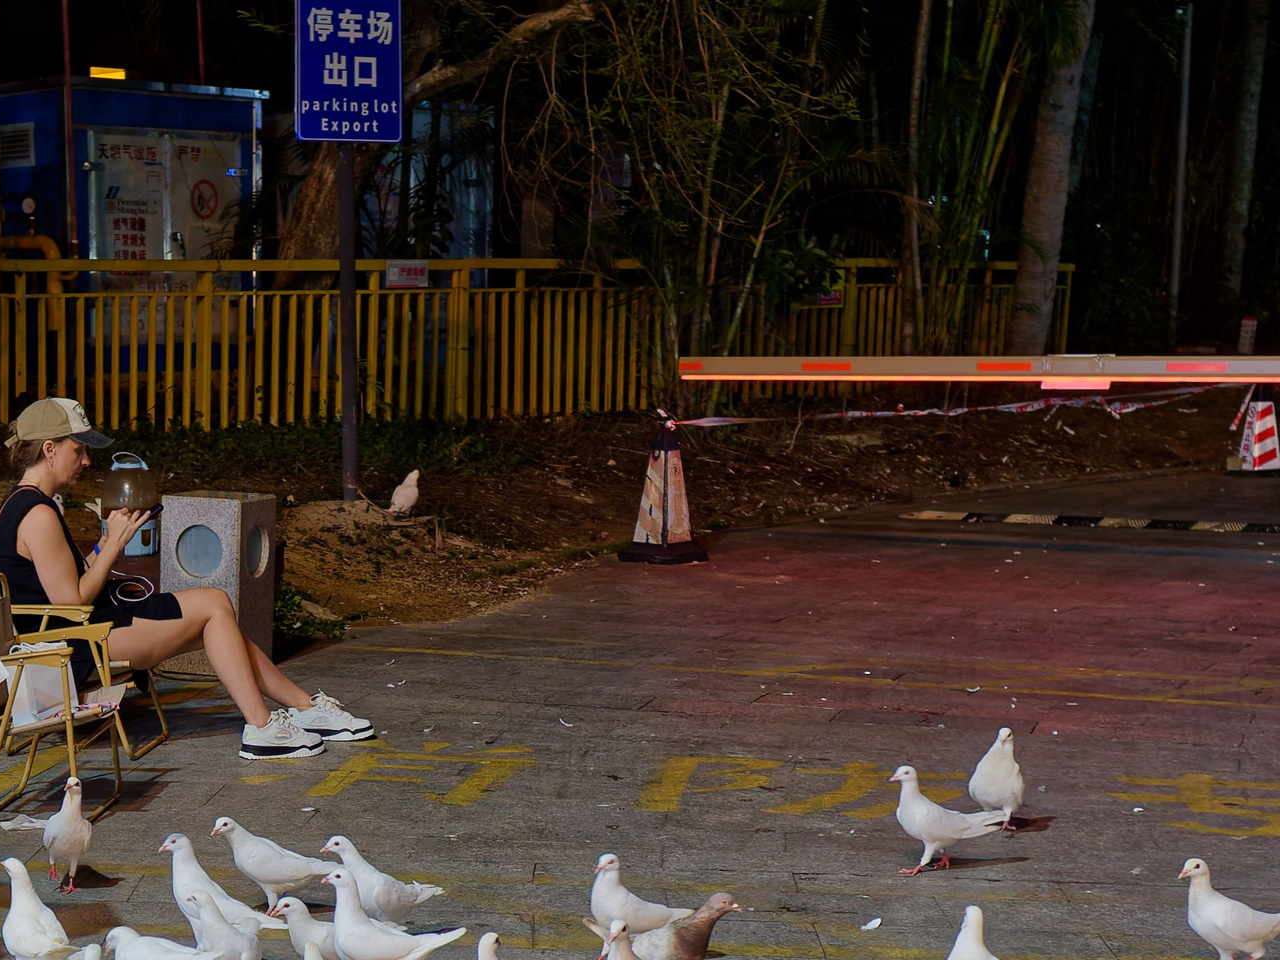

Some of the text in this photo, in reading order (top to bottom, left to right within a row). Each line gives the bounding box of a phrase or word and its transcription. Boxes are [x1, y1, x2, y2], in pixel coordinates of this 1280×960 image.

[307, 7, 393, 45] 停车场
[323, 52, 377, 87] 出口
[321, 118, 379, 134] Export
